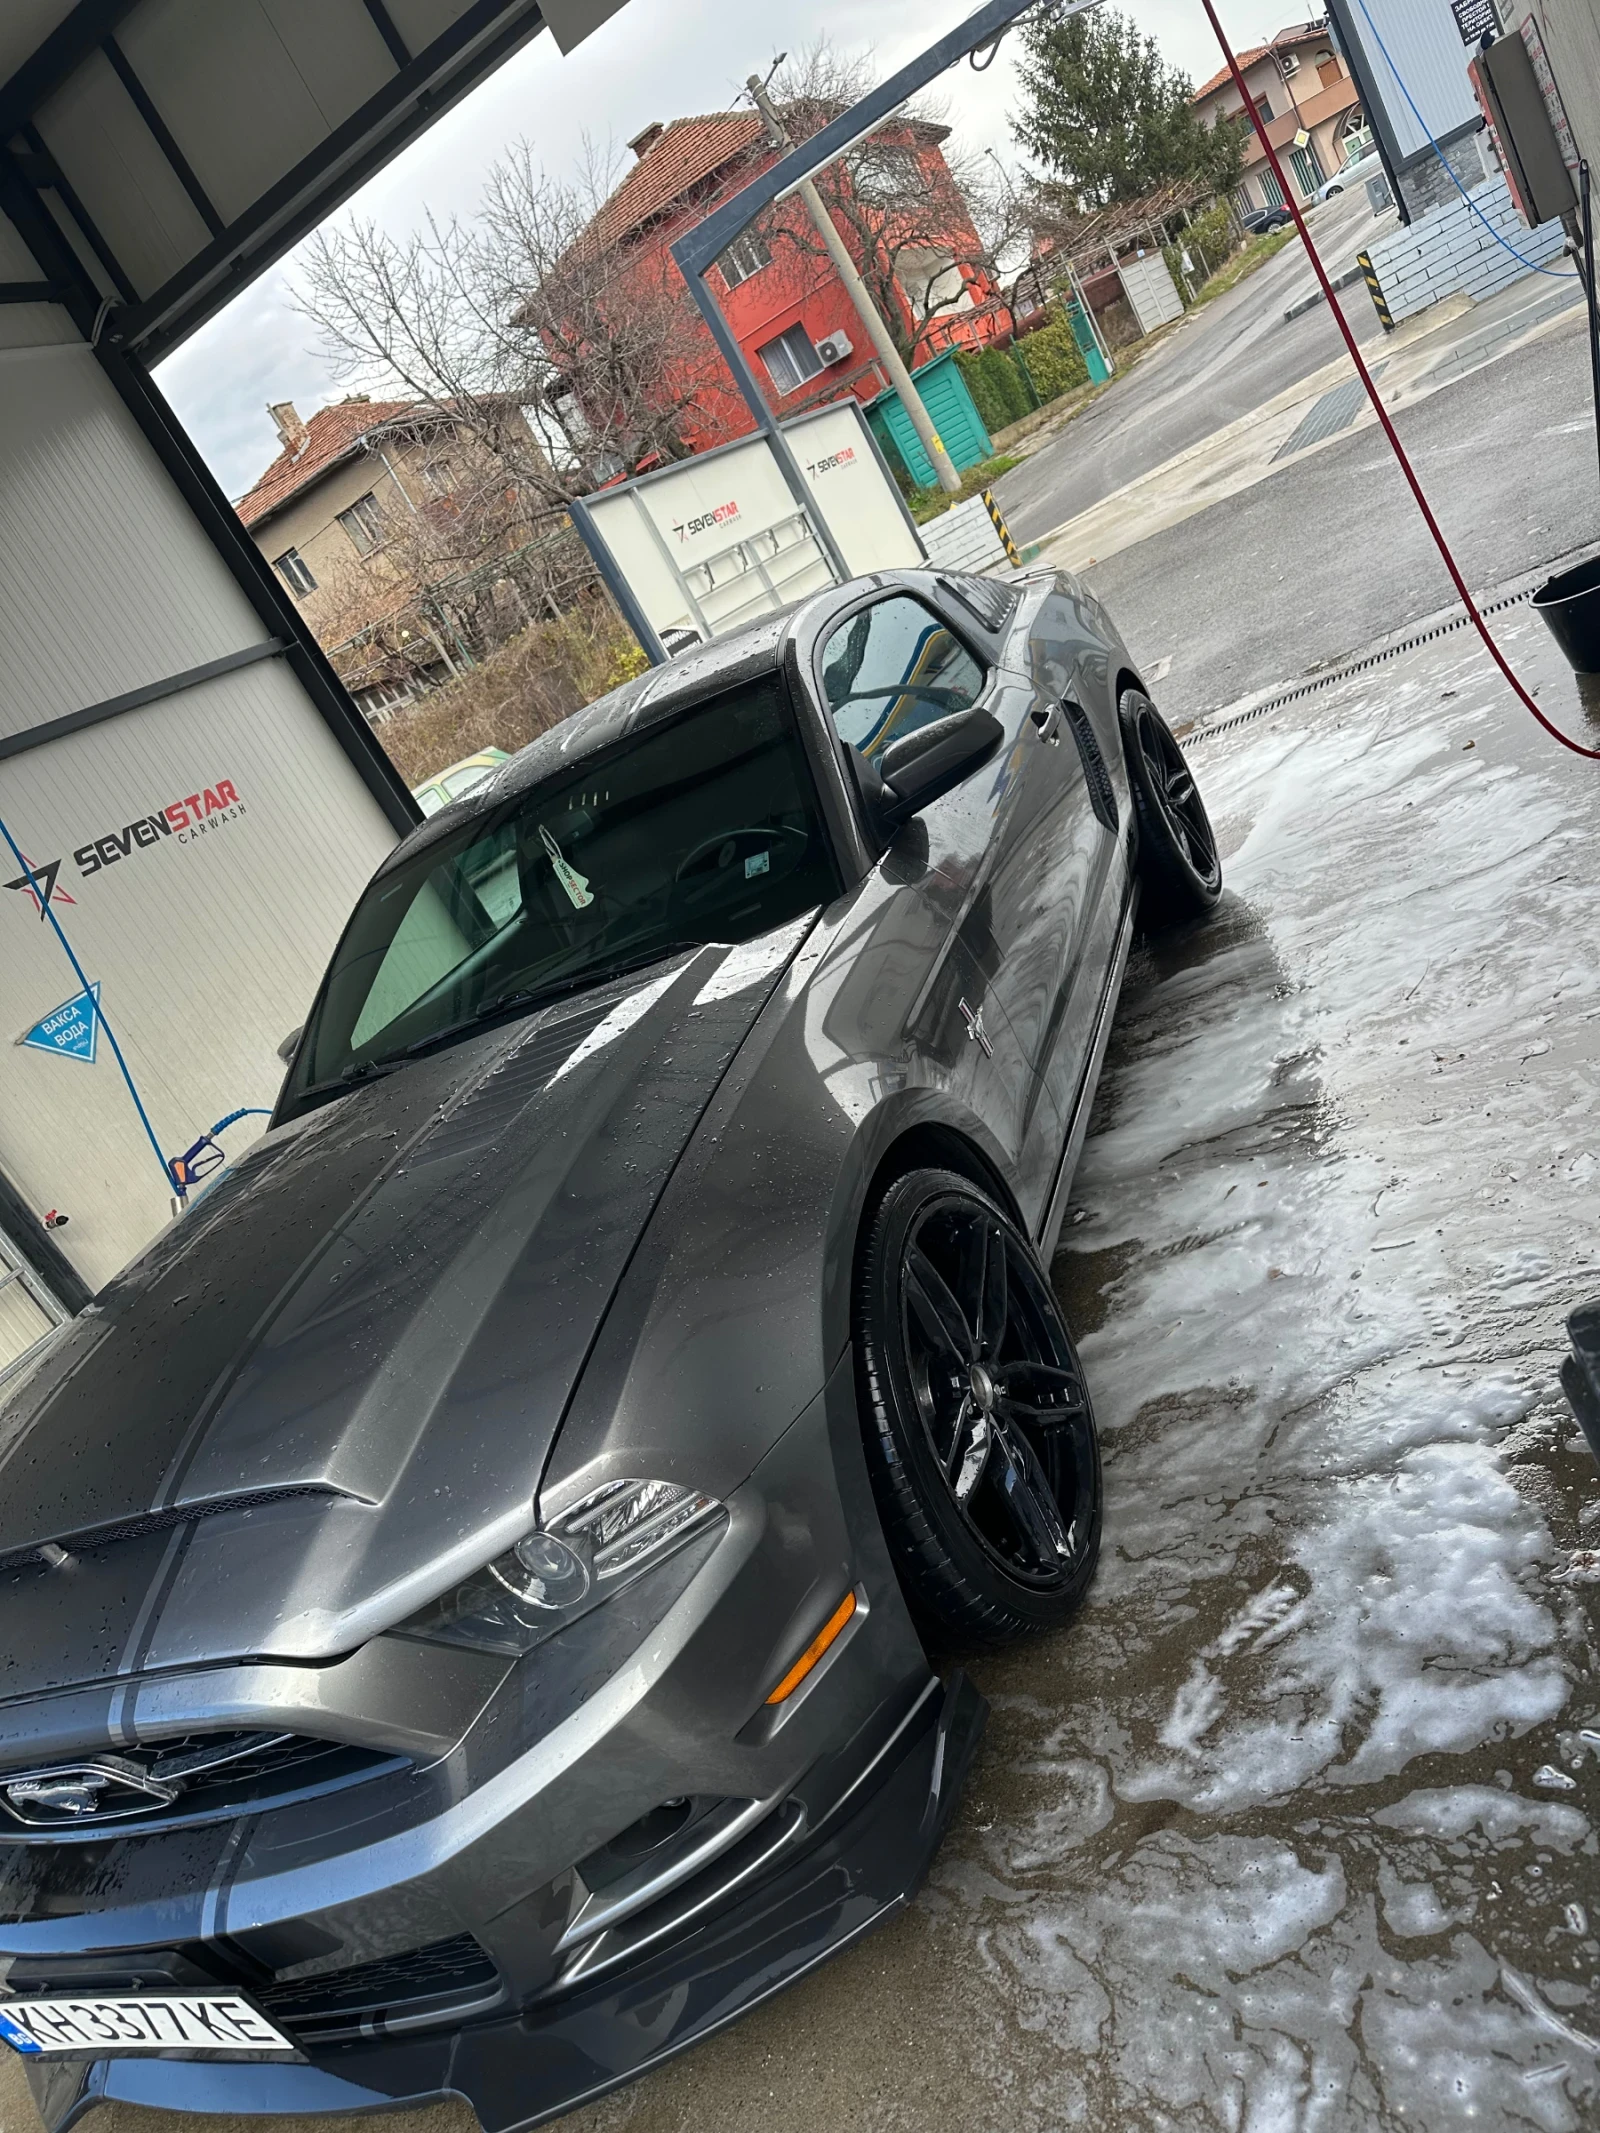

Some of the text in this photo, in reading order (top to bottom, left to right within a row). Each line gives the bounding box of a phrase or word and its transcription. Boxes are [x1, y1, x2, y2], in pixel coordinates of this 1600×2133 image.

[687, 501, 739, 535] SEVENSTAR
[73, 779, 240, 877] SEVENSTAR
[178, 803, 247, 844] CARWASH
[41, 1006, 82, 1035] ВАКСА
[54, 1021, 89, 1046] ВОДА
[8, 2033, 33, 2045] BG
